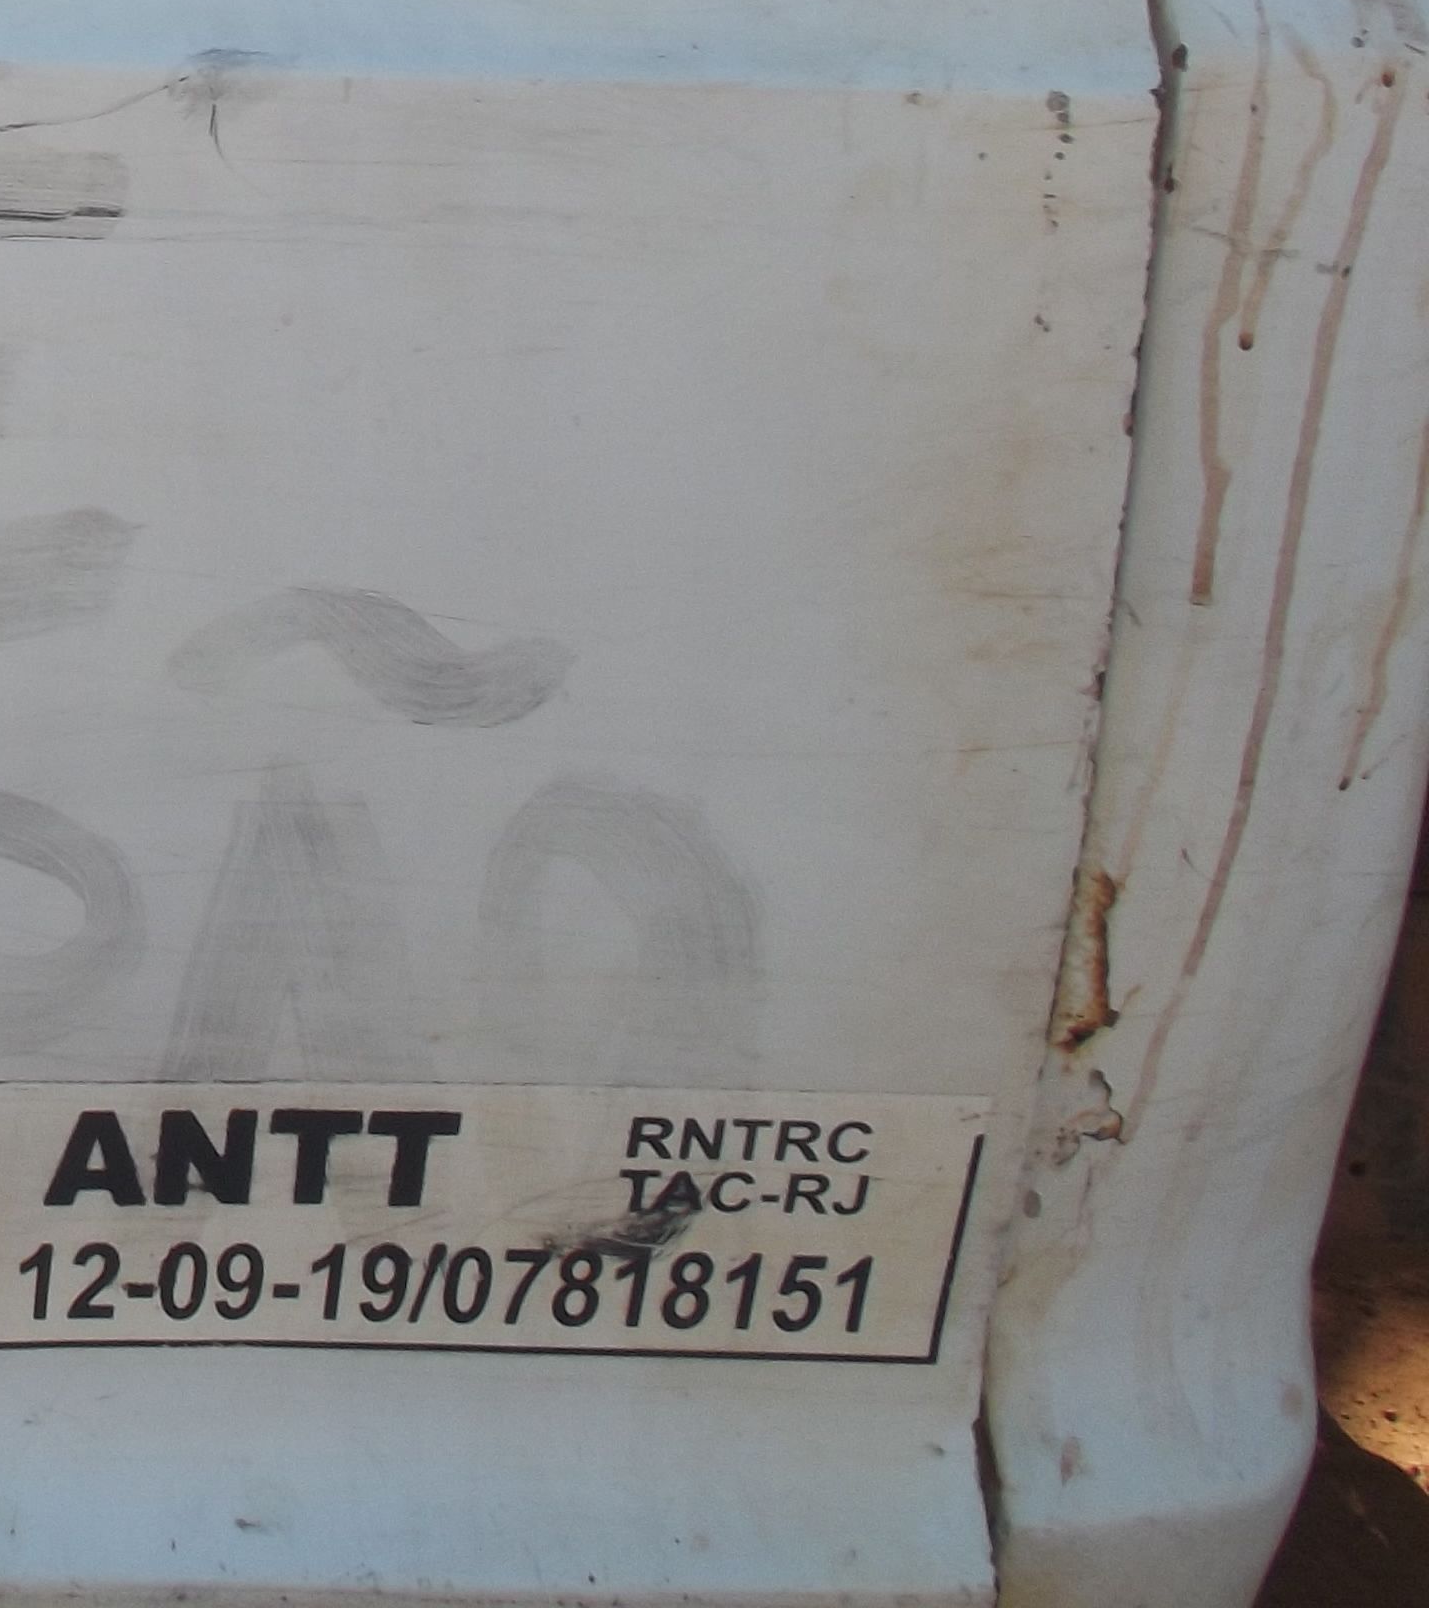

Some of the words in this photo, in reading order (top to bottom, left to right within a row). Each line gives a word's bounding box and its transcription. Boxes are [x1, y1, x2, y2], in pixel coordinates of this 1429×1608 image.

[43, 1108, 463, 1208] ANTT
[626, 1115, 874, 1165] RNTRC
[620, 1168, 871, 1218] TAC-RJ
[17, 1241, 876, 1335] 12-09-19/07818151
